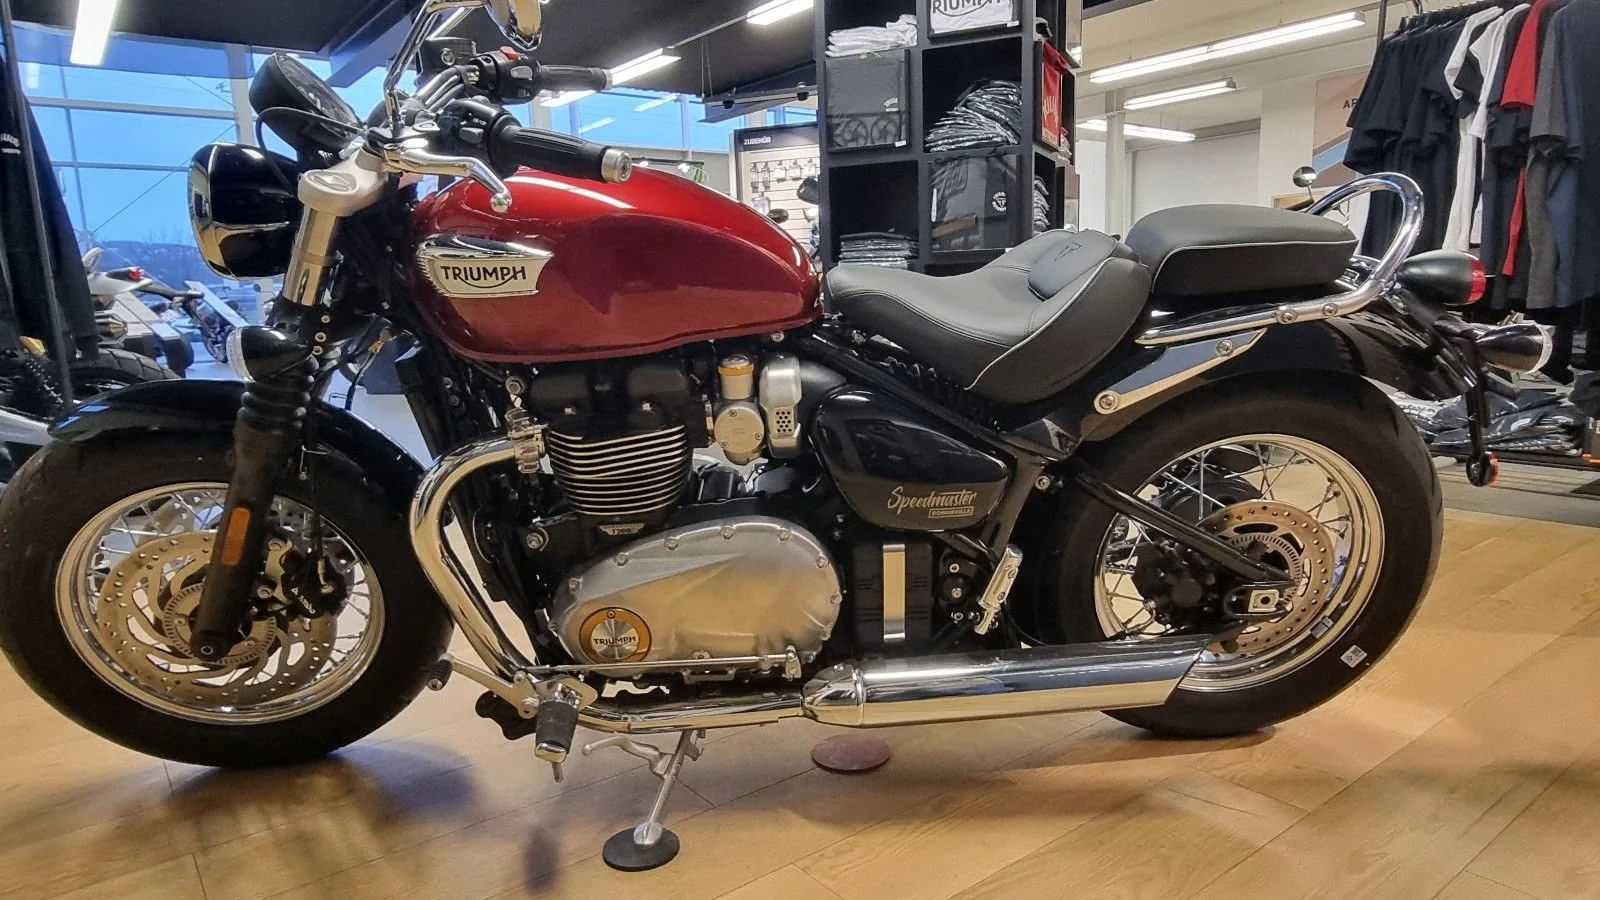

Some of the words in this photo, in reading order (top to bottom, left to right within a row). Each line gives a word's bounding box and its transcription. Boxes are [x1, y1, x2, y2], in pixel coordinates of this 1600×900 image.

[440, 265, 527, 288] TRIUMPH
[887, 485, 978, 515] Speedmaster
[593, 636, 636, 647] TRIUMPH
